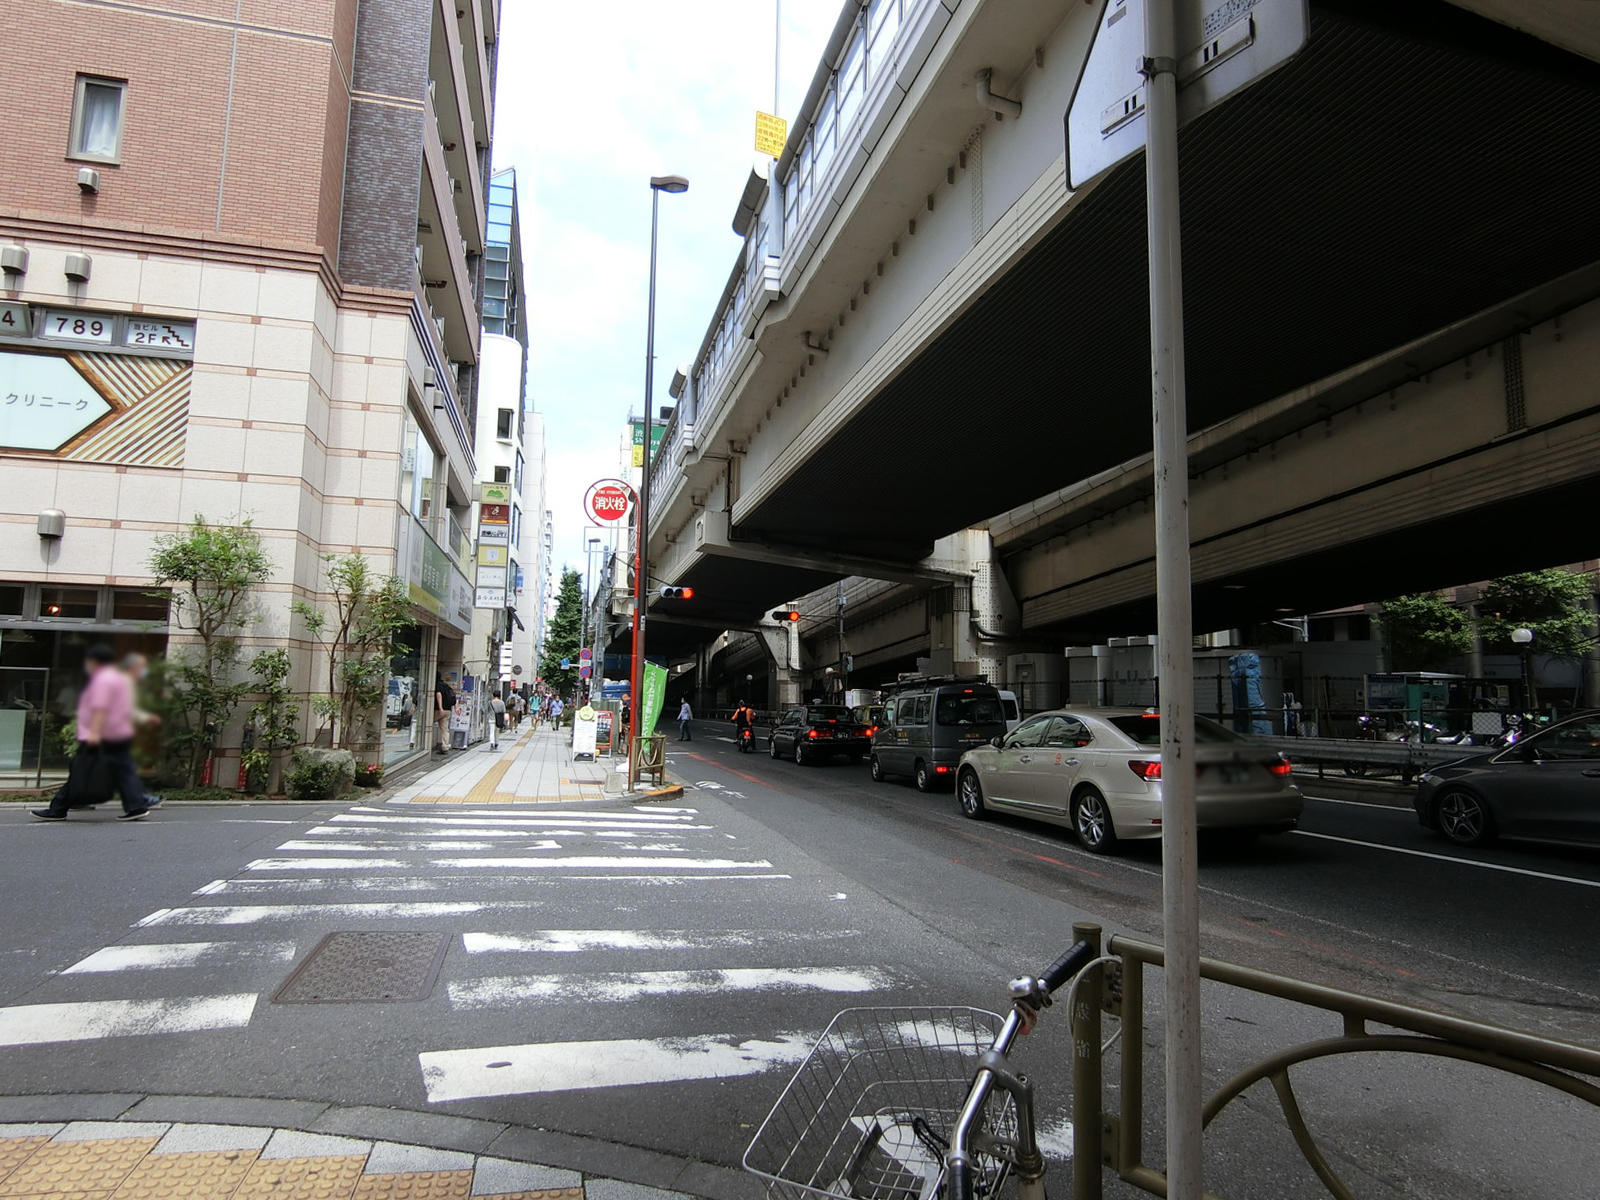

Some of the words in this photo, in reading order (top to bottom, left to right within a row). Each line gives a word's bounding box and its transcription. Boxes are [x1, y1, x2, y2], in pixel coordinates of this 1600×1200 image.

[1, 310, 15, 327] 4
[56, 317, 104, 336] 789
[135, 332, 157, 344] 2F
[6, 393, 88, 411] クリニーク
[595, 497, 626, 511] 消火栓
